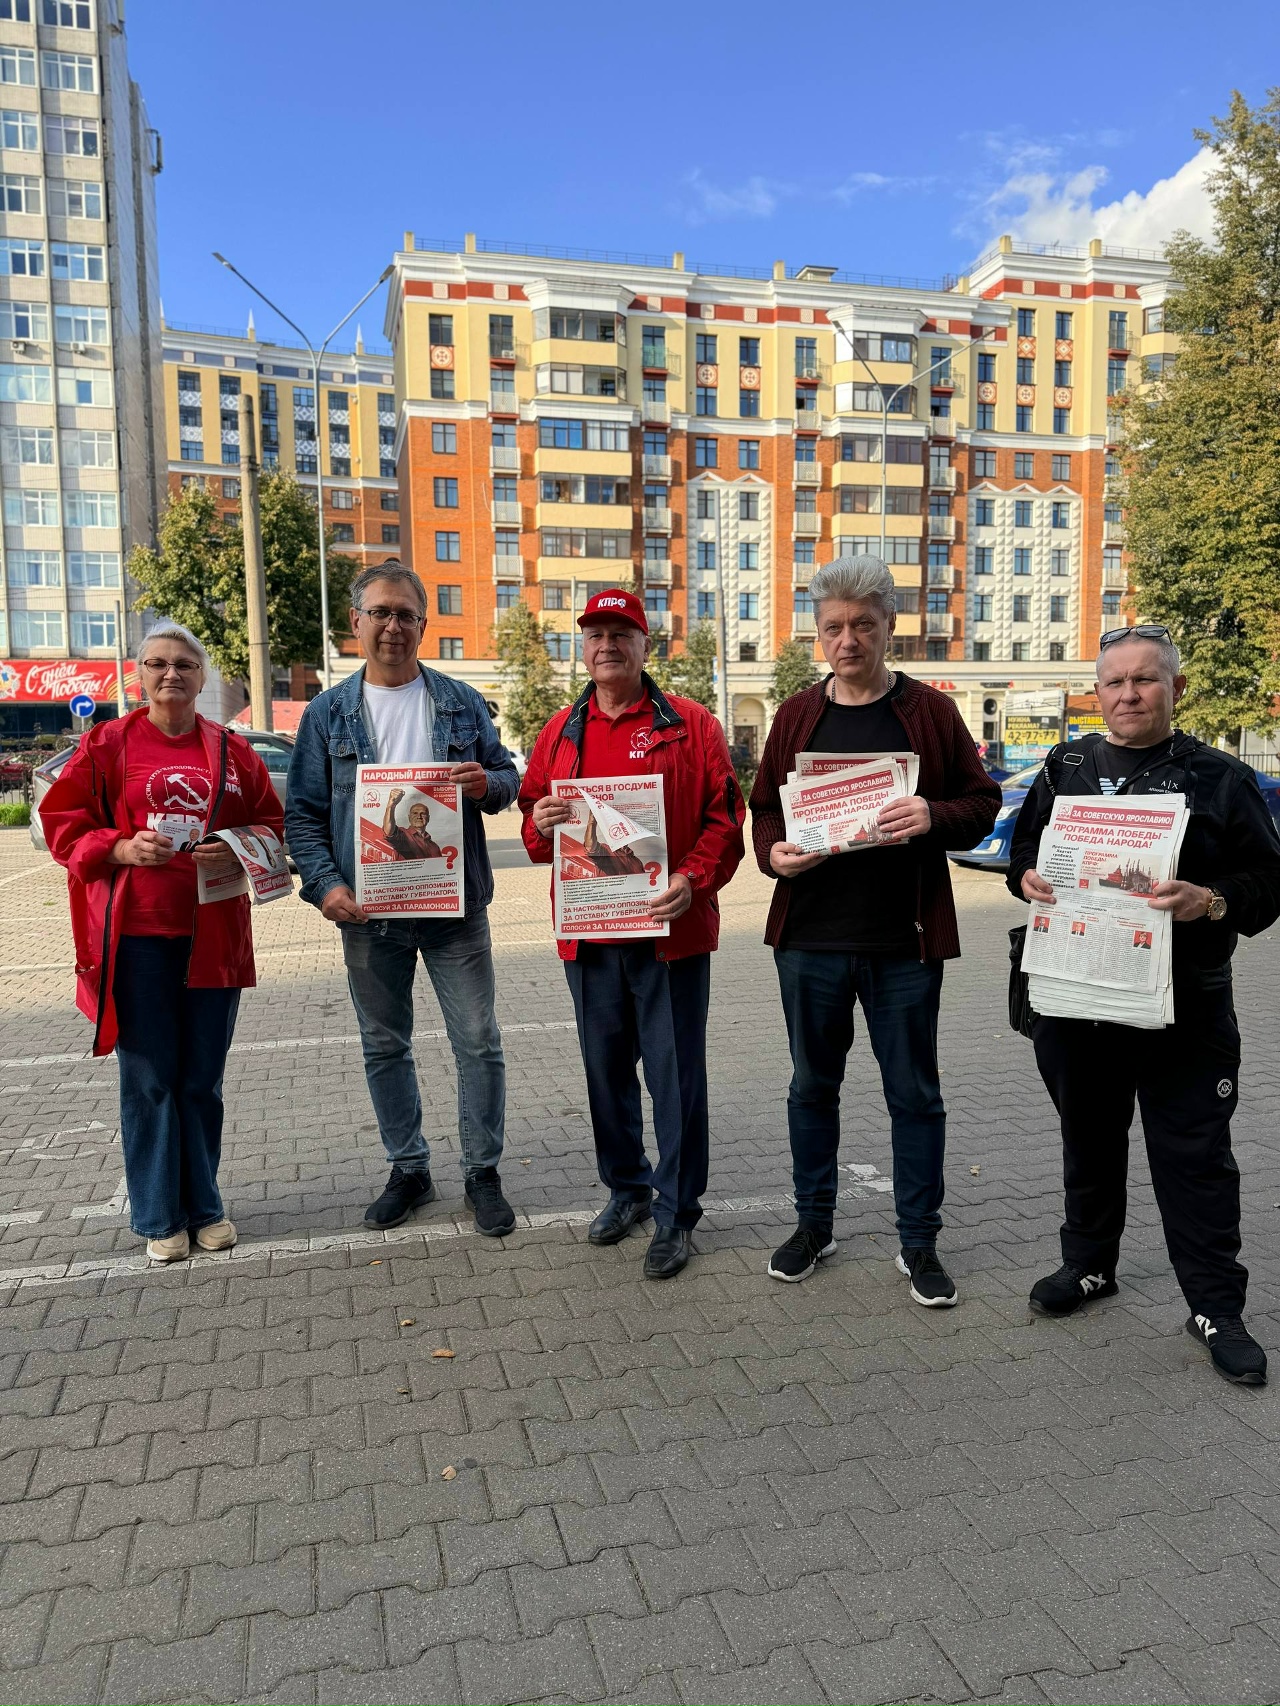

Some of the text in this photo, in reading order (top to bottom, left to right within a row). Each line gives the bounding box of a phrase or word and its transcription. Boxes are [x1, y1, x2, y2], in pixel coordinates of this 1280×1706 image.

[597, 597, 627, 609] КПРФ
[51, 673, 113, 699] Победы!
[629, 750, 647, 759] КП
[814, 763, 861, 771] ЗА СОВЕТСК
[363, 768, 452, 781] НАРОДНЫЙ ДЕПУТА
[560, 787, 582, 797] НАР
[605, 784, 612, 792] В
[613, 781, 657, 791] ГОСДУМЕ
[812, 785, 850, 800] СОВЕТСКУЮ
[850, 775, 893, 791] ЯРОСЛАВИЮ!
[793, 799, 848, 819] ПРОГРАММА
[850, 791, 889, 807] ПОБЕДЫ
[805, 801, 884, 825] ПОБЕДА НАРОДА!
[1082, 812, 1125, 822] СОВЕТСКУЮ
[1125, 815, 1173, 825] ЯРОСЛАВИЮ!
[1053, 823, 1114, 836] ПРОГРАММА
[1117, 829, 1162, 840] ПОБЕДЫ
[1063, 833, 1153, 849] ПОБЕДА НАРОДА!
[373, 886, 414, 895] НАСТОЯЩУЮ
[415, 882, 458, 890] ОППОЗИЦИЮ!
[375, 893, 409, 901] ОТСТАВКУ
[410, 889, 458, 898] ГУБЕРНАТОРА!
[573, 904, 616, 912] НАСТОЯЩУЮ
[574, 912, 610, 921] ОТСТАВКУ
[611, 907, 652, 917] ГУБЕРНАТО
[604, 921, 662, 930] ПАРАМОНОВА!
